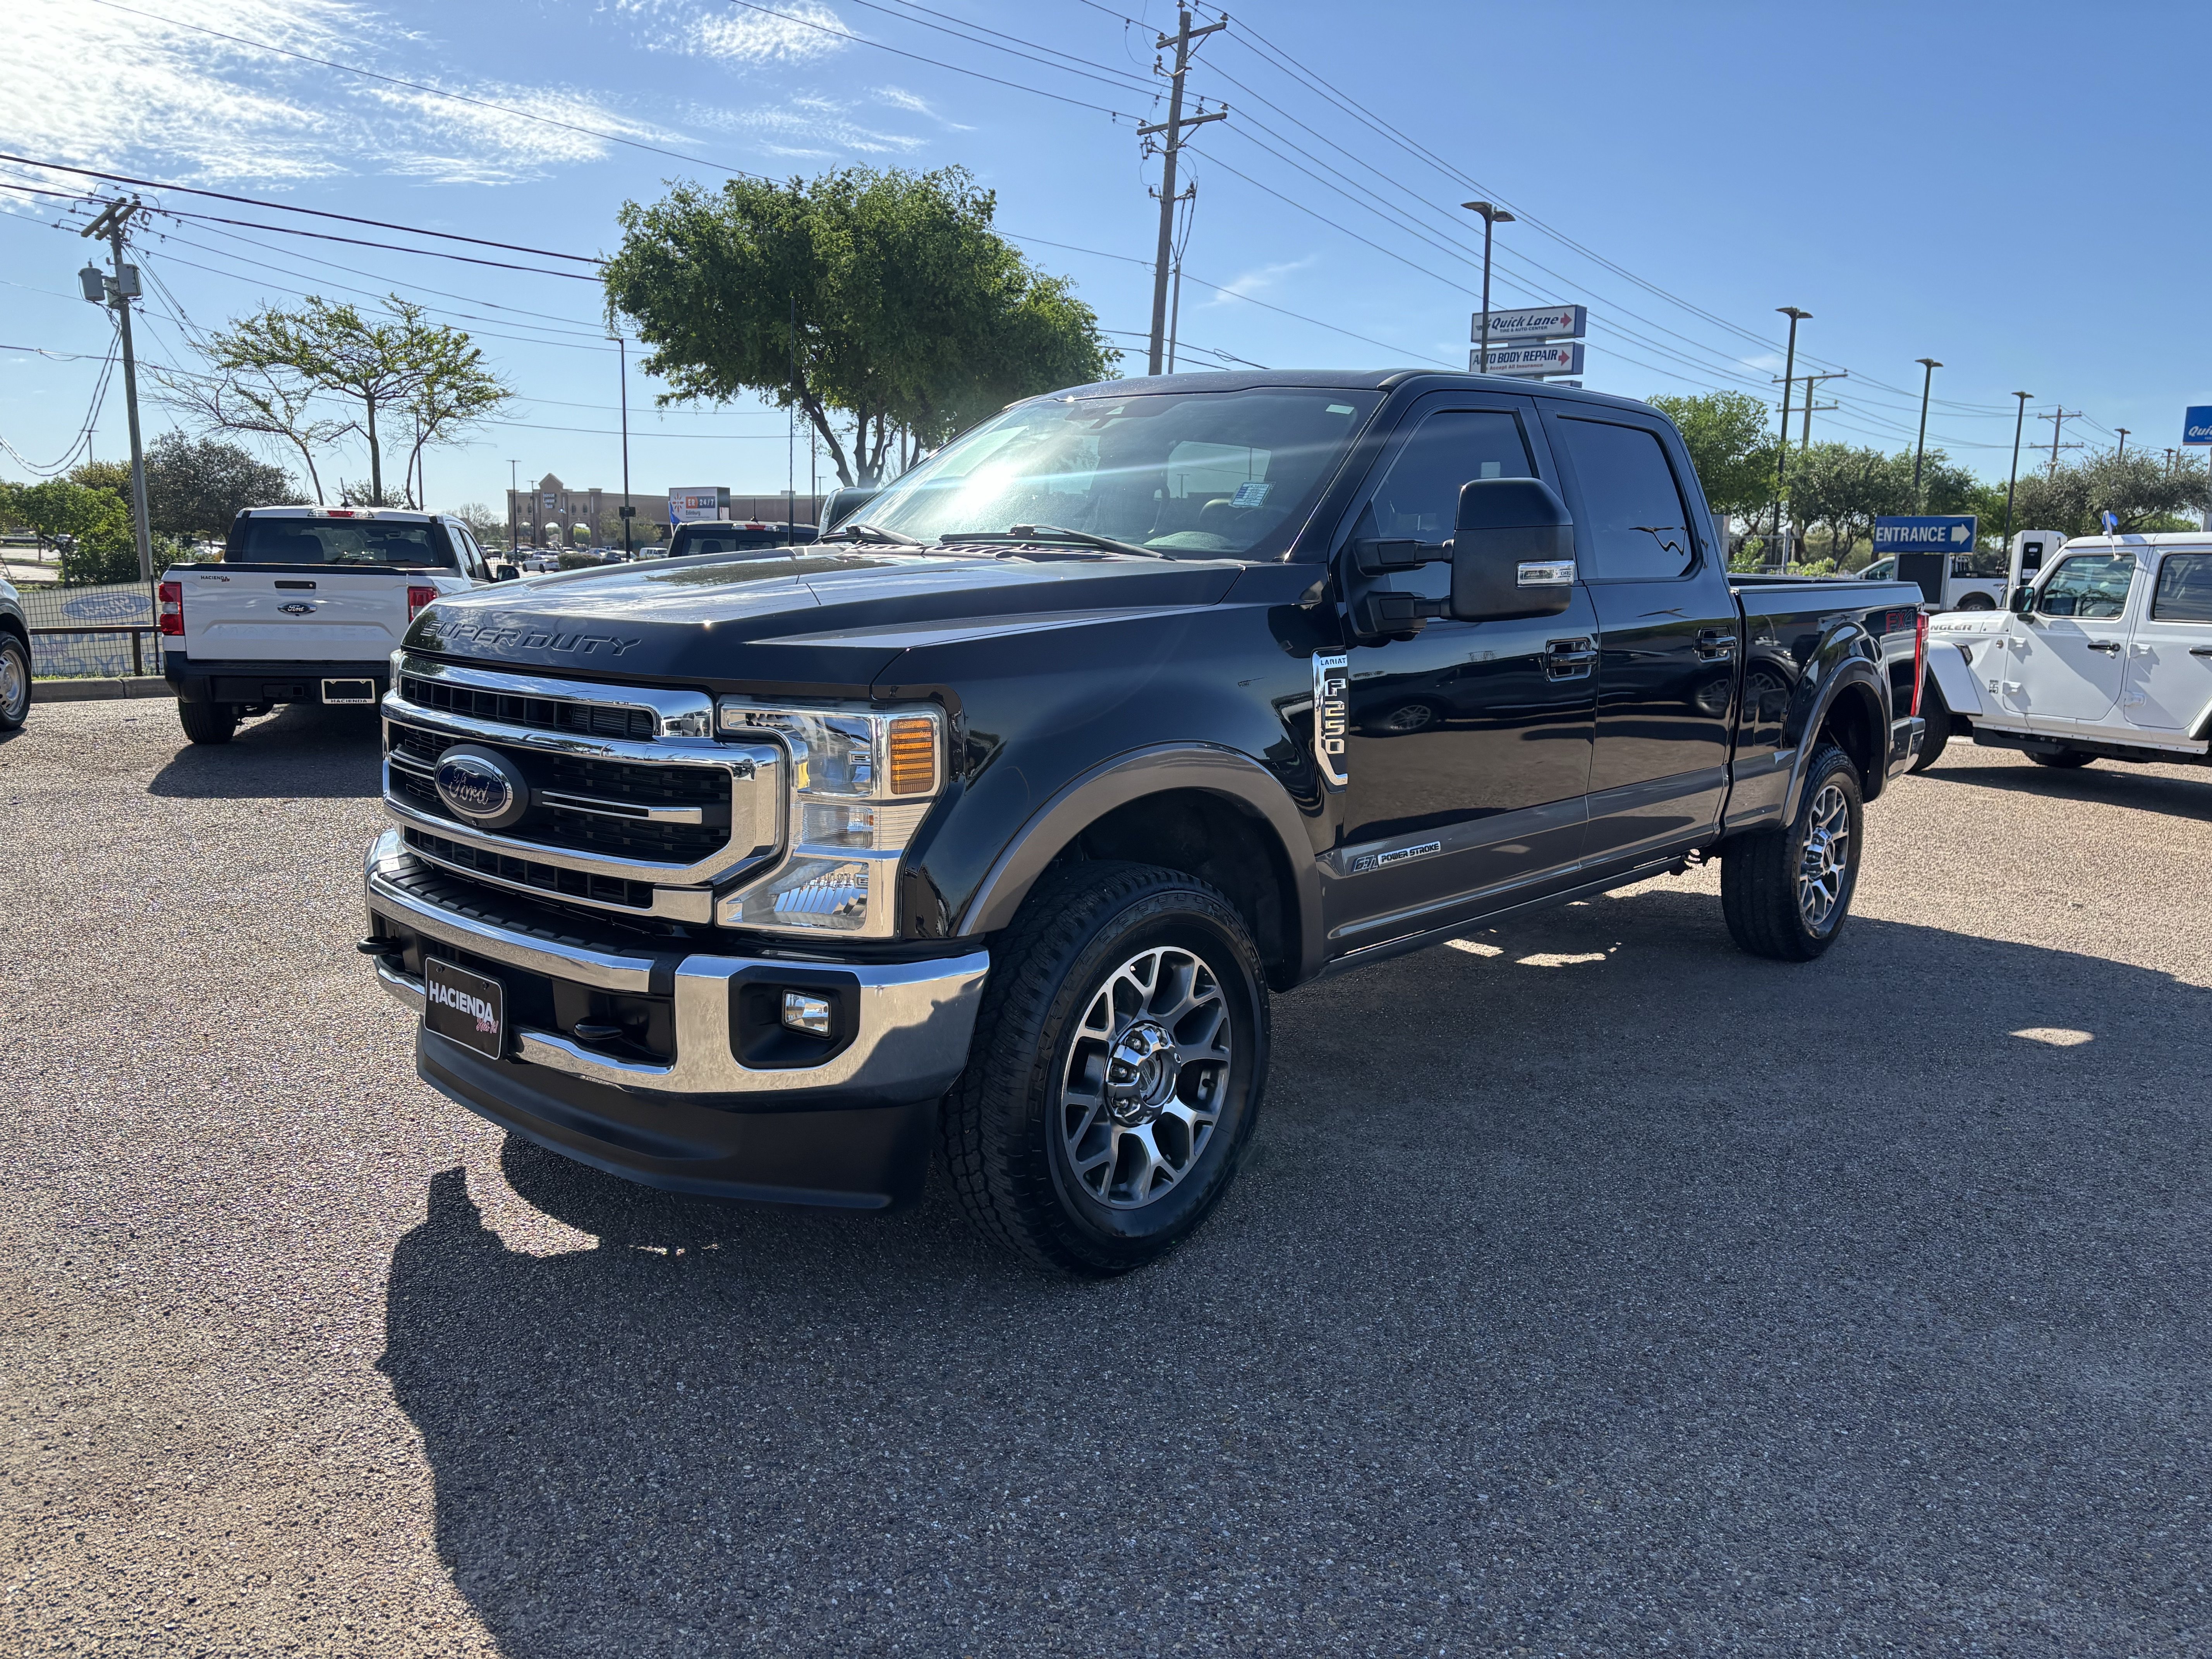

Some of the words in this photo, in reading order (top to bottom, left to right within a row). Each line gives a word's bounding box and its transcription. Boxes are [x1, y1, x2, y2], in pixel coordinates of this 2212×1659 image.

[1492, 316, 1525, 330] Quick
[1526, 315, 1559, 326] Lane
[1497, 351, 1522, 363] BODY
[1523, 349, 1558, 362] REPAIR
[1875, 527, 1946, 542] ENTRANCE
[1886, 609, 1914, 634] FX4
[421, 620, 523, 647] SUPER
[522, 630, 641, 656] DUTY
[1321, 657, 1346, 666] LARIAT
[448, 767, 489, 805] Ford
[1381, 850, 1408, 863] POWER
[1410, 843, 1439, 856] STROKE
[429, 980, 494, 1024] HACIENDA
